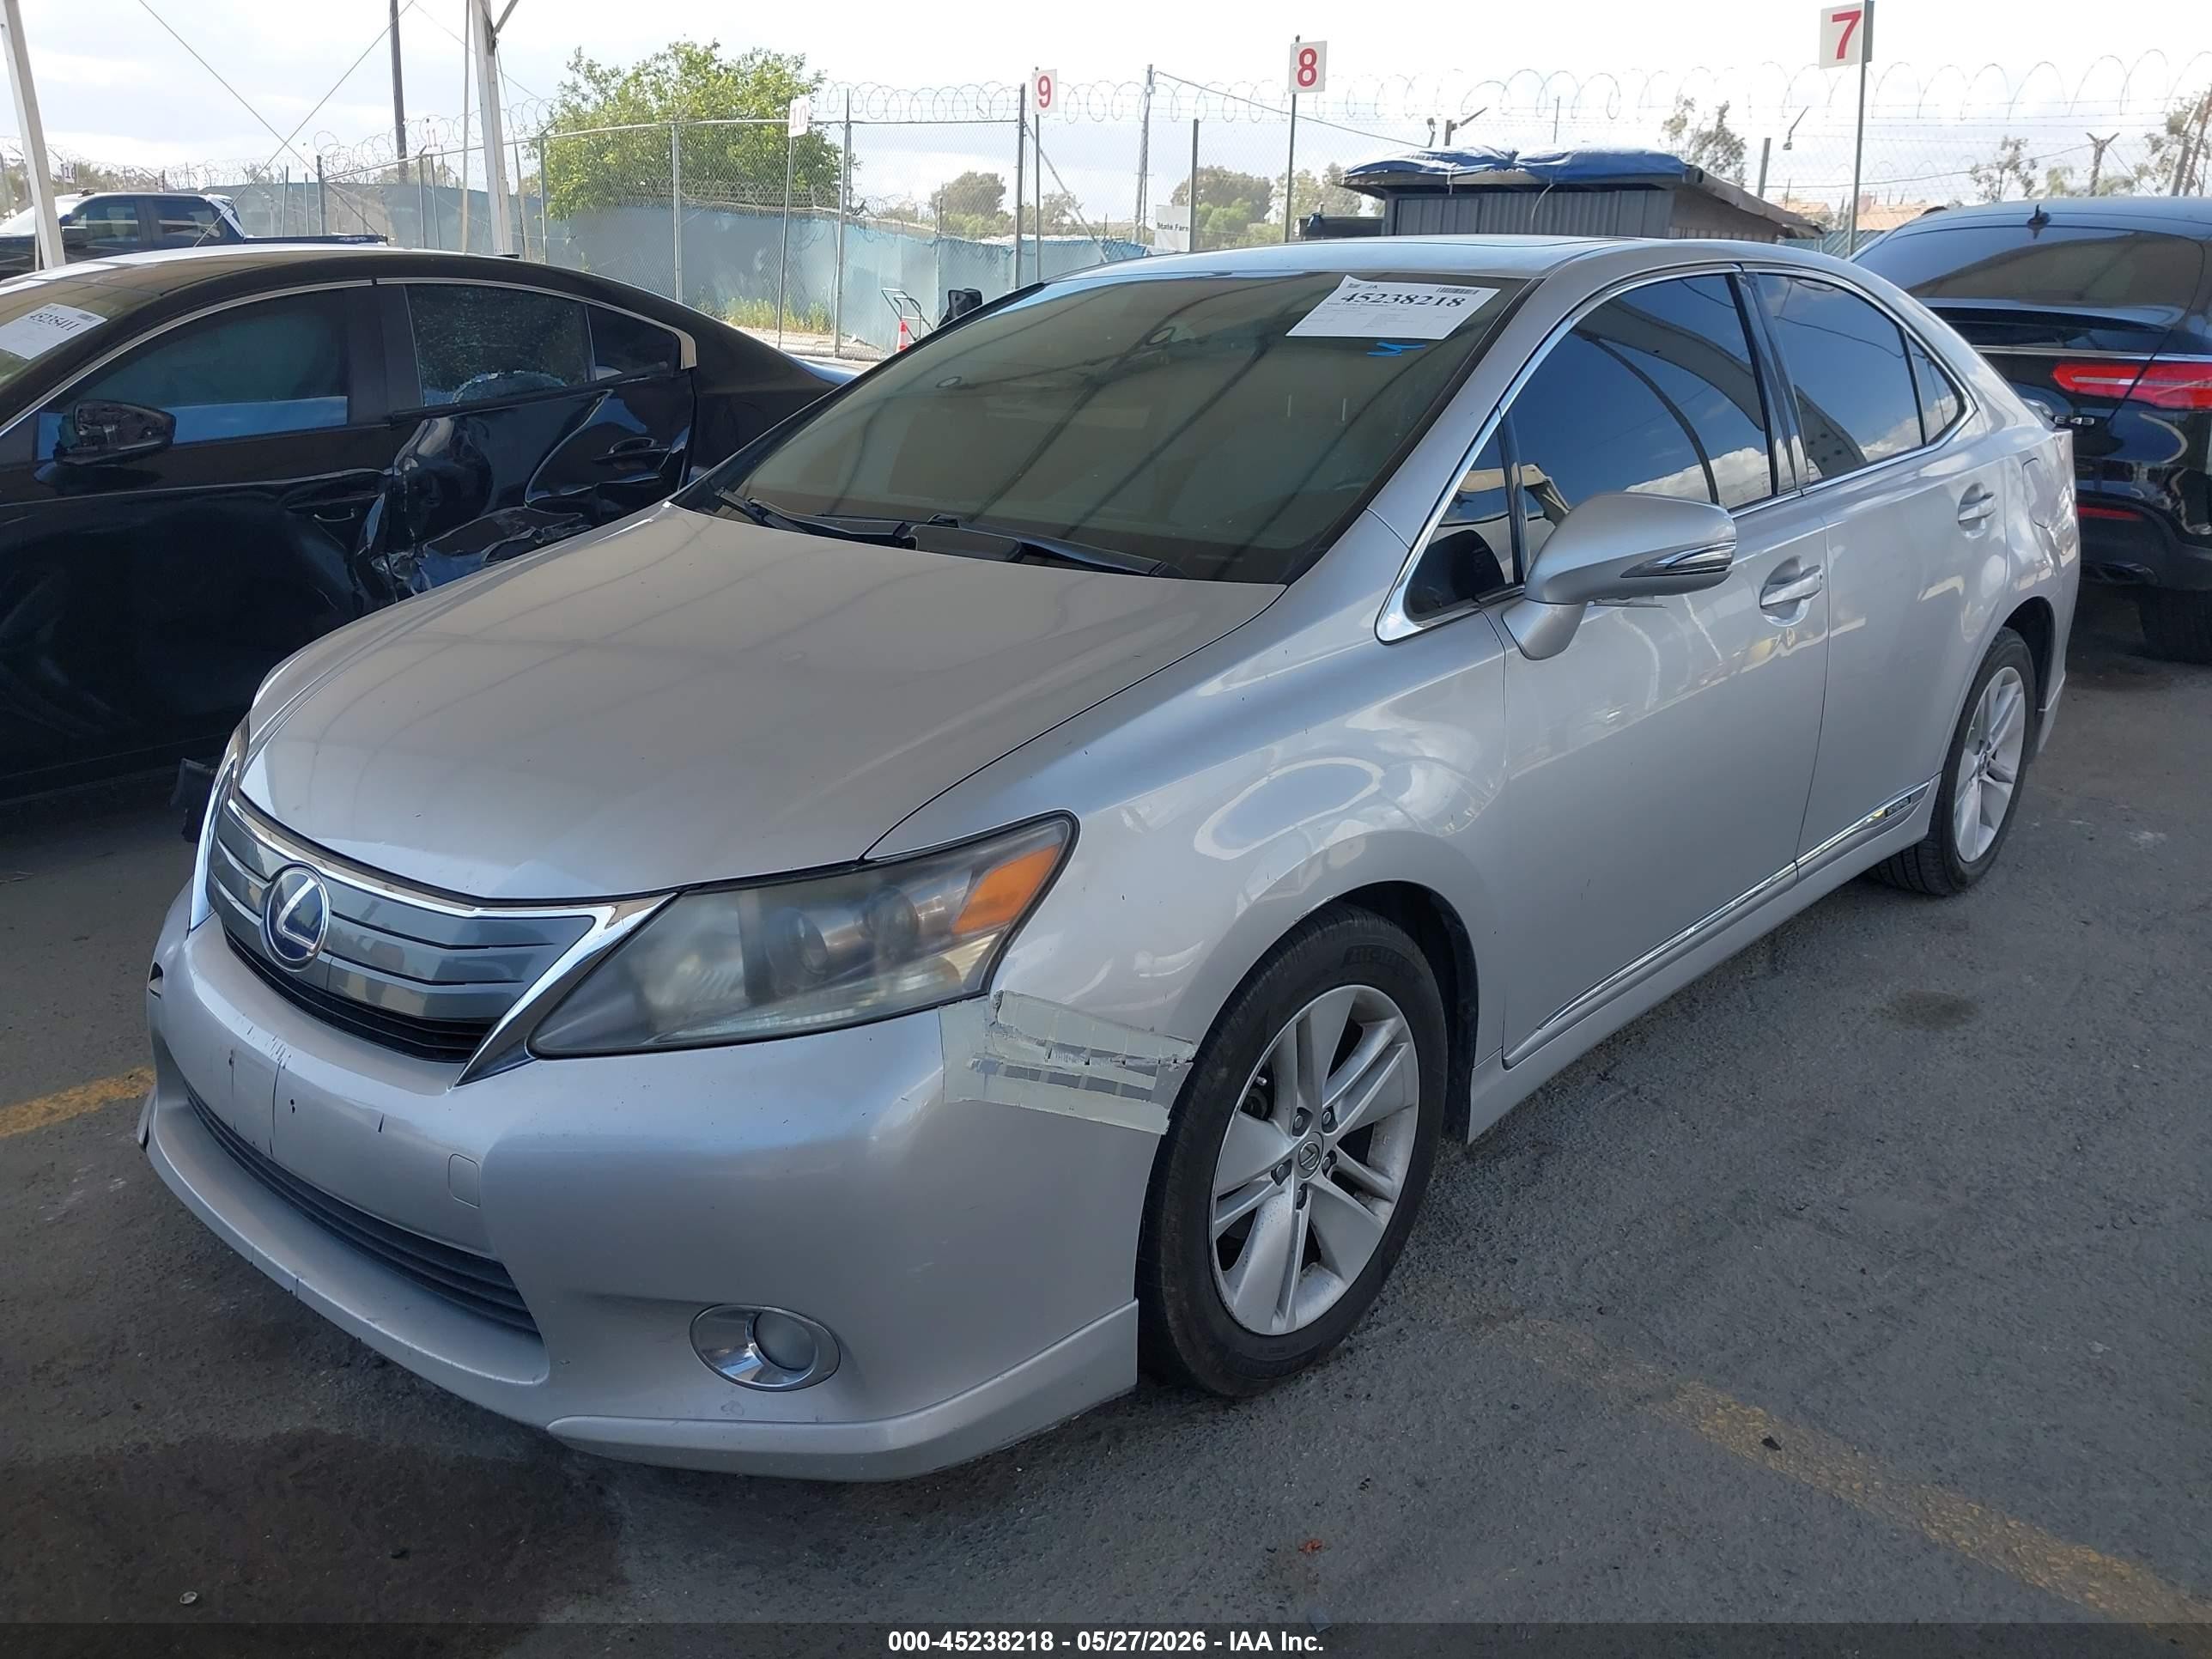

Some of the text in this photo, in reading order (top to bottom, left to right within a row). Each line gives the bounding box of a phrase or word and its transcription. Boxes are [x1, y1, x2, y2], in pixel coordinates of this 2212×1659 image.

[1832, 9, 1862, 60] 7
[1297, 47, 1317, 88] 8
[1037, 75, 1051, 109] 9
[790, 105, 807, 130] 10
[426, 128, 439, 149] 11
[1340, 292, 1467, 308] 45238218
